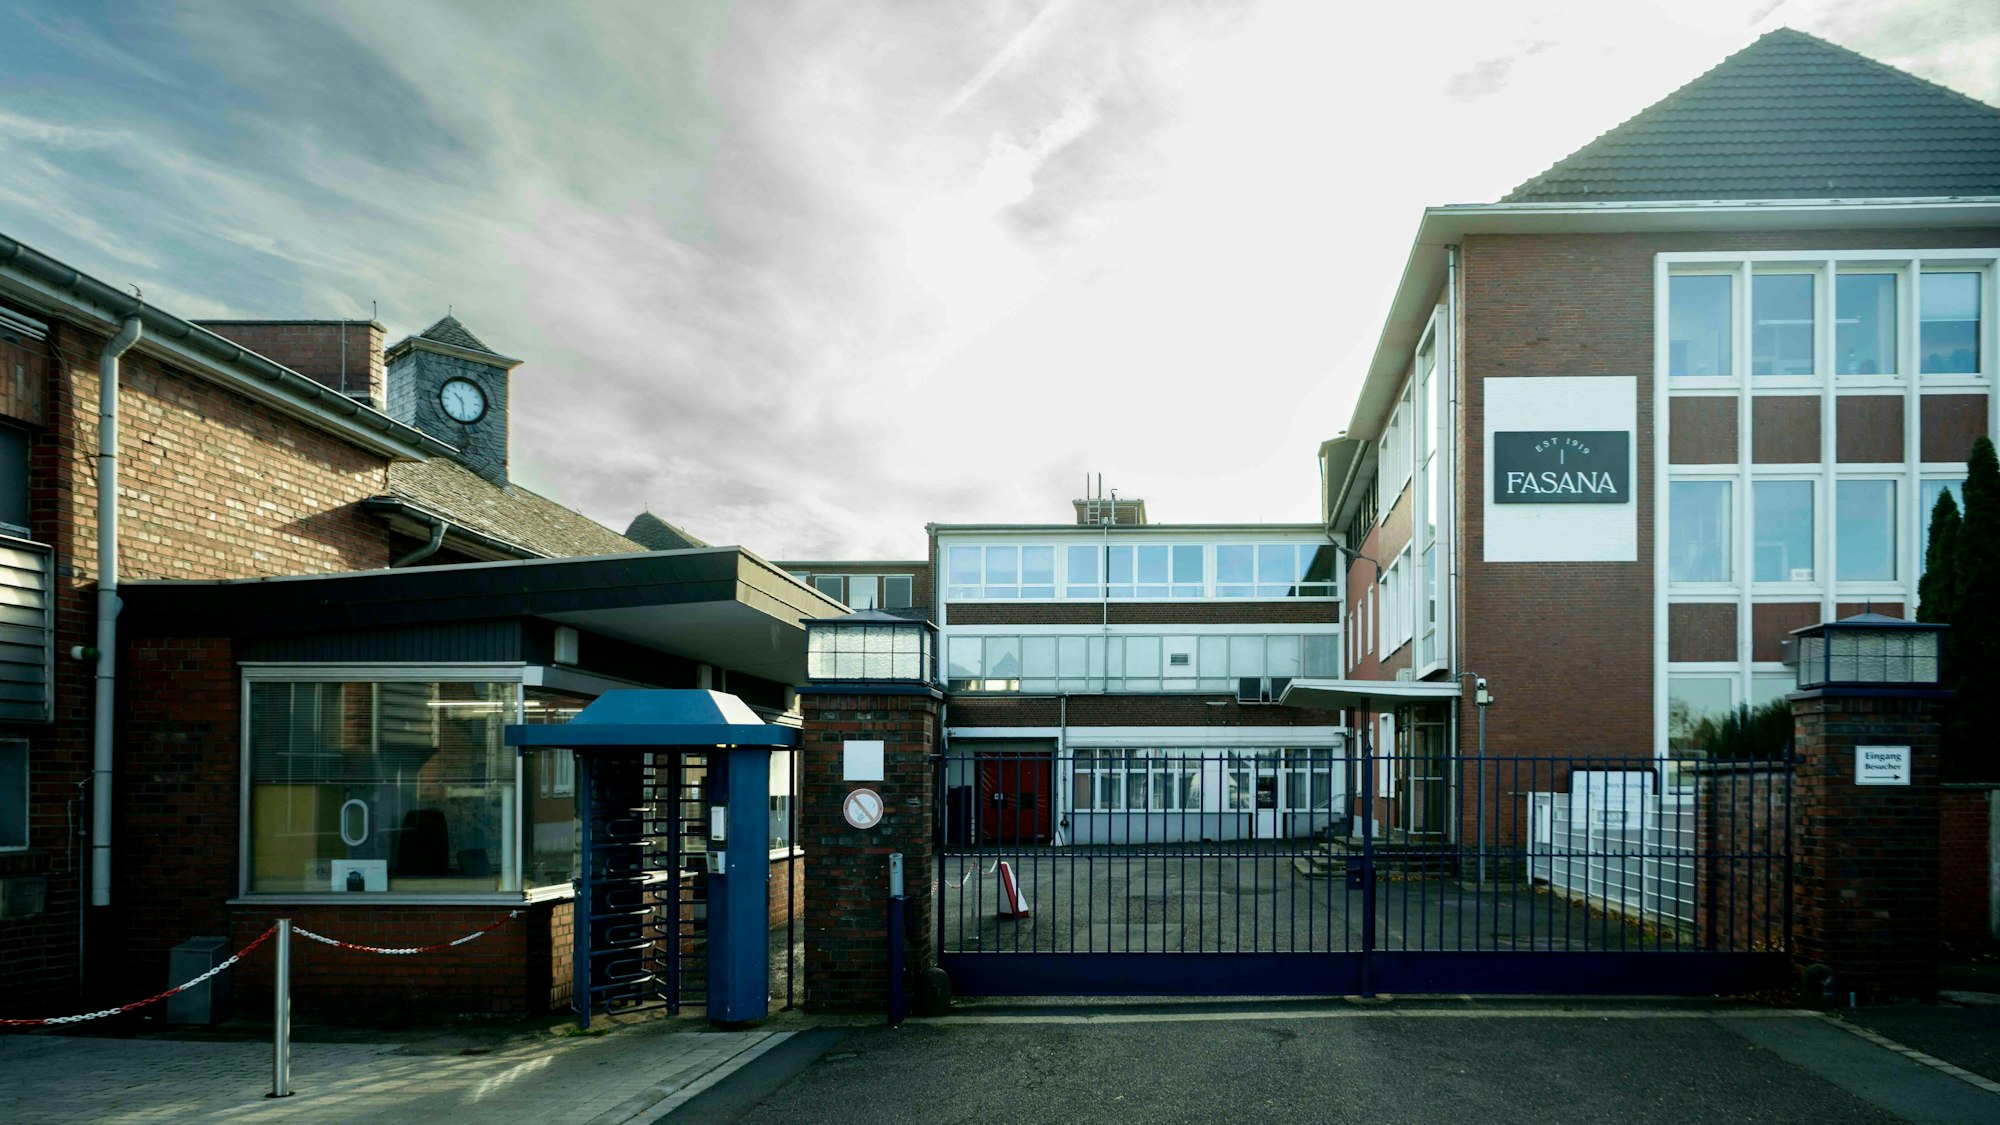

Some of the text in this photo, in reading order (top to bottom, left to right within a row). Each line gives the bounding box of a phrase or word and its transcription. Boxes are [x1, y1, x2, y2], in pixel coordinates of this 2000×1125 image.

[1535, 437, 1590, 455] EST 1919
[1507, 471, 1618, 494] FASANA
[1865, 752, 1902, 762] Eingang
